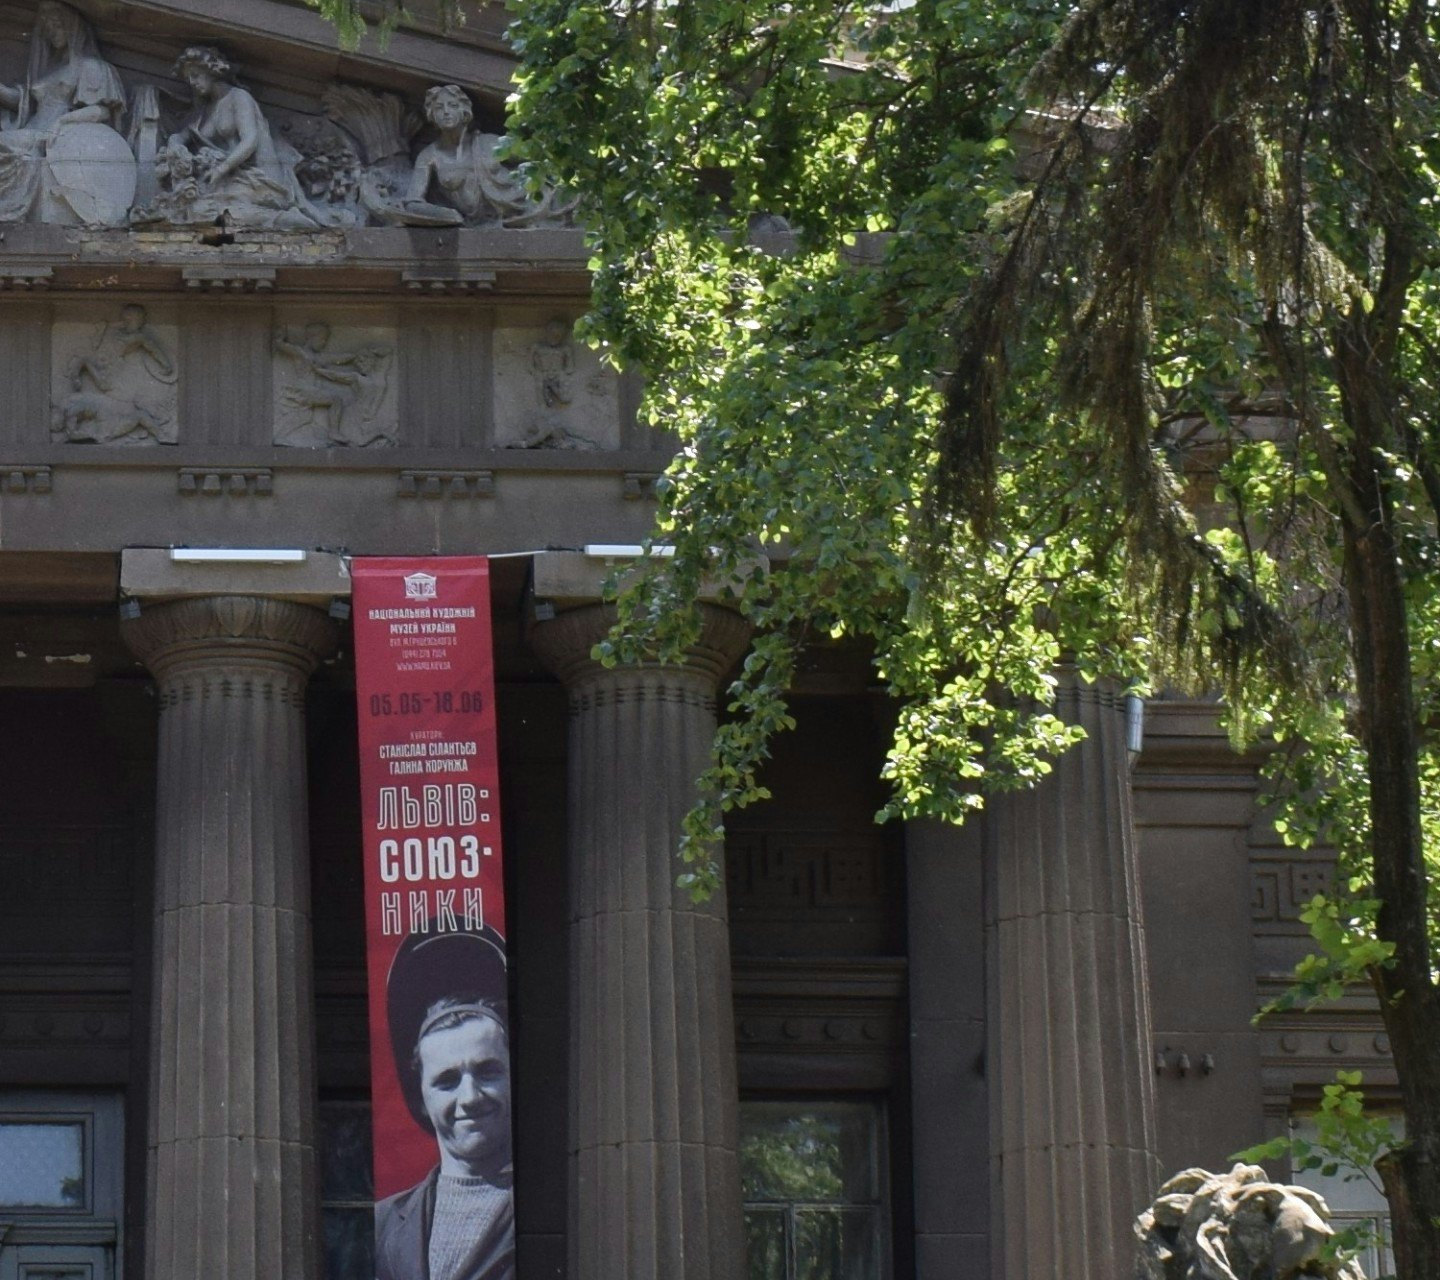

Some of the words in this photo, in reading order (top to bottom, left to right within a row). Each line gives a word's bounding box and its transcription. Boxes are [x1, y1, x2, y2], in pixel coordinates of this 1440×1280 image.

[390, 622, 418, 634] МУЗЕЙ
[421, 622, 455, 633] УКРАЇНИ
[379, 743, 426, 758] СТАНІСЛАВ
[429, 742, 476, 757] СІЛАНТЬЄВ
[390, 761, 423, 775] ГАЛИНА
[425, 759, 468, 773] ХОРУНЖА
[377, 783, 490, 830] ЛЬВІВ:
[382, 888, 484, 935] НИКИ
